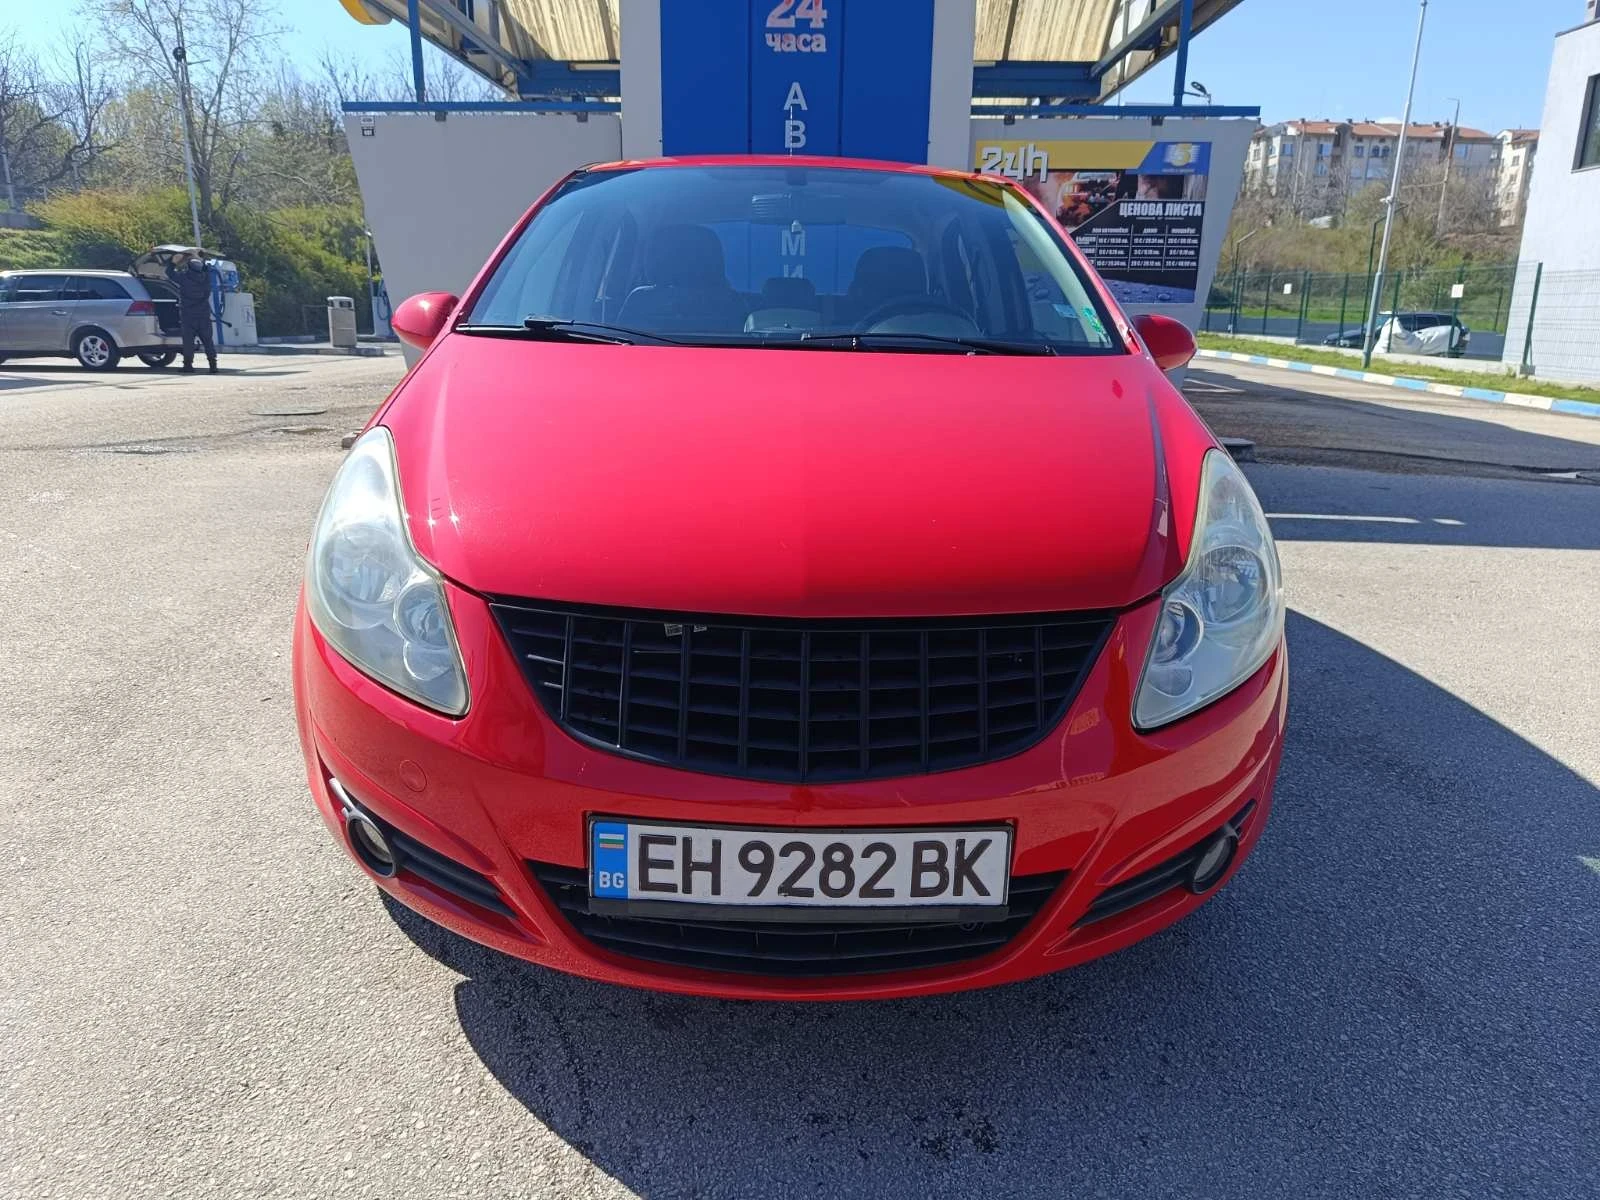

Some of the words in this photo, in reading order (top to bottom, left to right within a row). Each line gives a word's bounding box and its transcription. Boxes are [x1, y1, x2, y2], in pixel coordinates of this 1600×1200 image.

[766, 0, 827, 28] 24
[765, 33, 827, 52] часа
[981, 144, 1048, 182] 24h
[1119, 202, 1163, 217] ЦЕНОВА
[1164, 202, 1202, 216] ЛИСТА
[638, 834, 722, 896] EH
[737, 840, 897, 898] 9282
[910, 838, 992, 898] BK
[598, 871, 625, 889] BG
